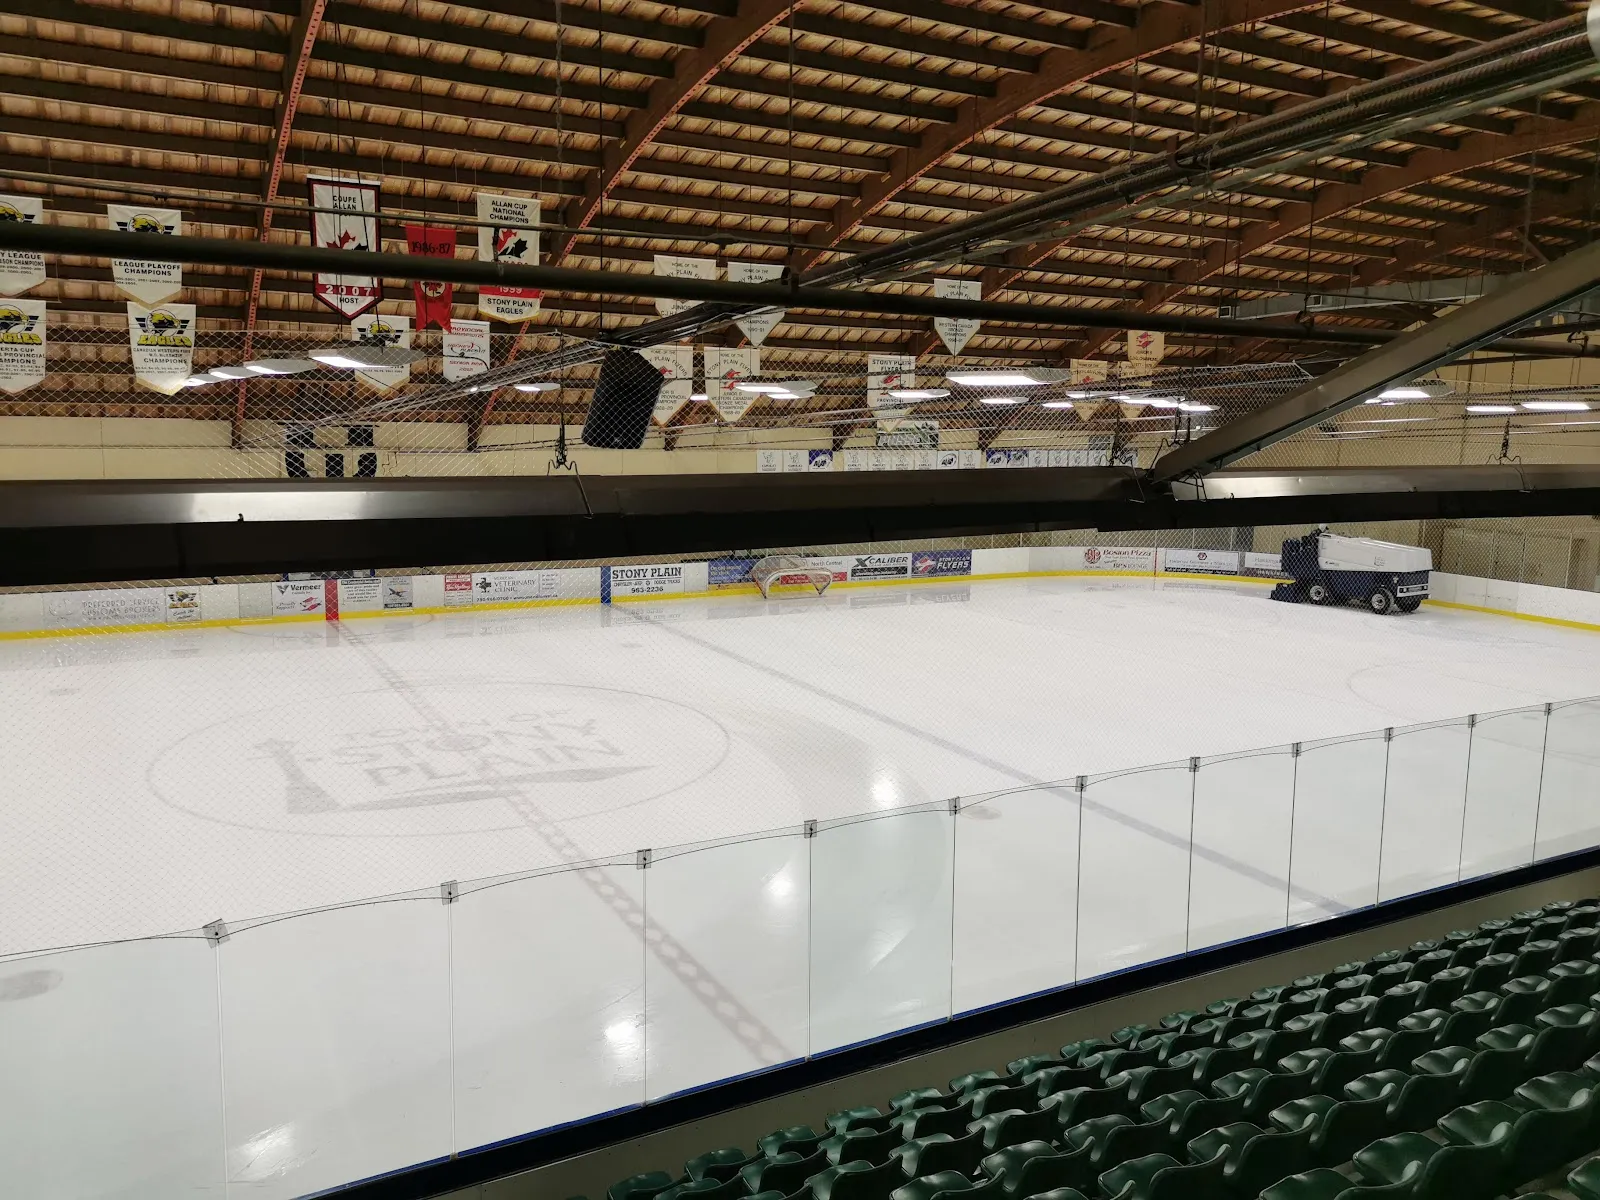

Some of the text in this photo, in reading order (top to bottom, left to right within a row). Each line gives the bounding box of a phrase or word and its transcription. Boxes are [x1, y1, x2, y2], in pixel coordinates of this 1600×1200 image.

[491, 200, 513, 209] ALLAN
[492, 207, 525, 217] NATIONAL
[489, 213, 529, 224] CHAMPIONS
[8, 252, 42, 260] LEAGUE
[14, 259, 44, 267] CHAMPIONS
[114, 260, 145, 268] LEAGUE
[124, 268, 172, 276] CHAMPIONS
[676, 269, 693, 277] PLAIN
[325, 284, 372, 297] 2007
[487, 297, 533, 308] STONY PLAIN
[496, 306, 524, 315] EAGLES
[137, 334, 193, 348] EAGLES
[936, 560, 970, 569] FLYERS
[612, 567, 682, 580] STONY PLAIN
[494, 579, 537, 587] VETERINARY
